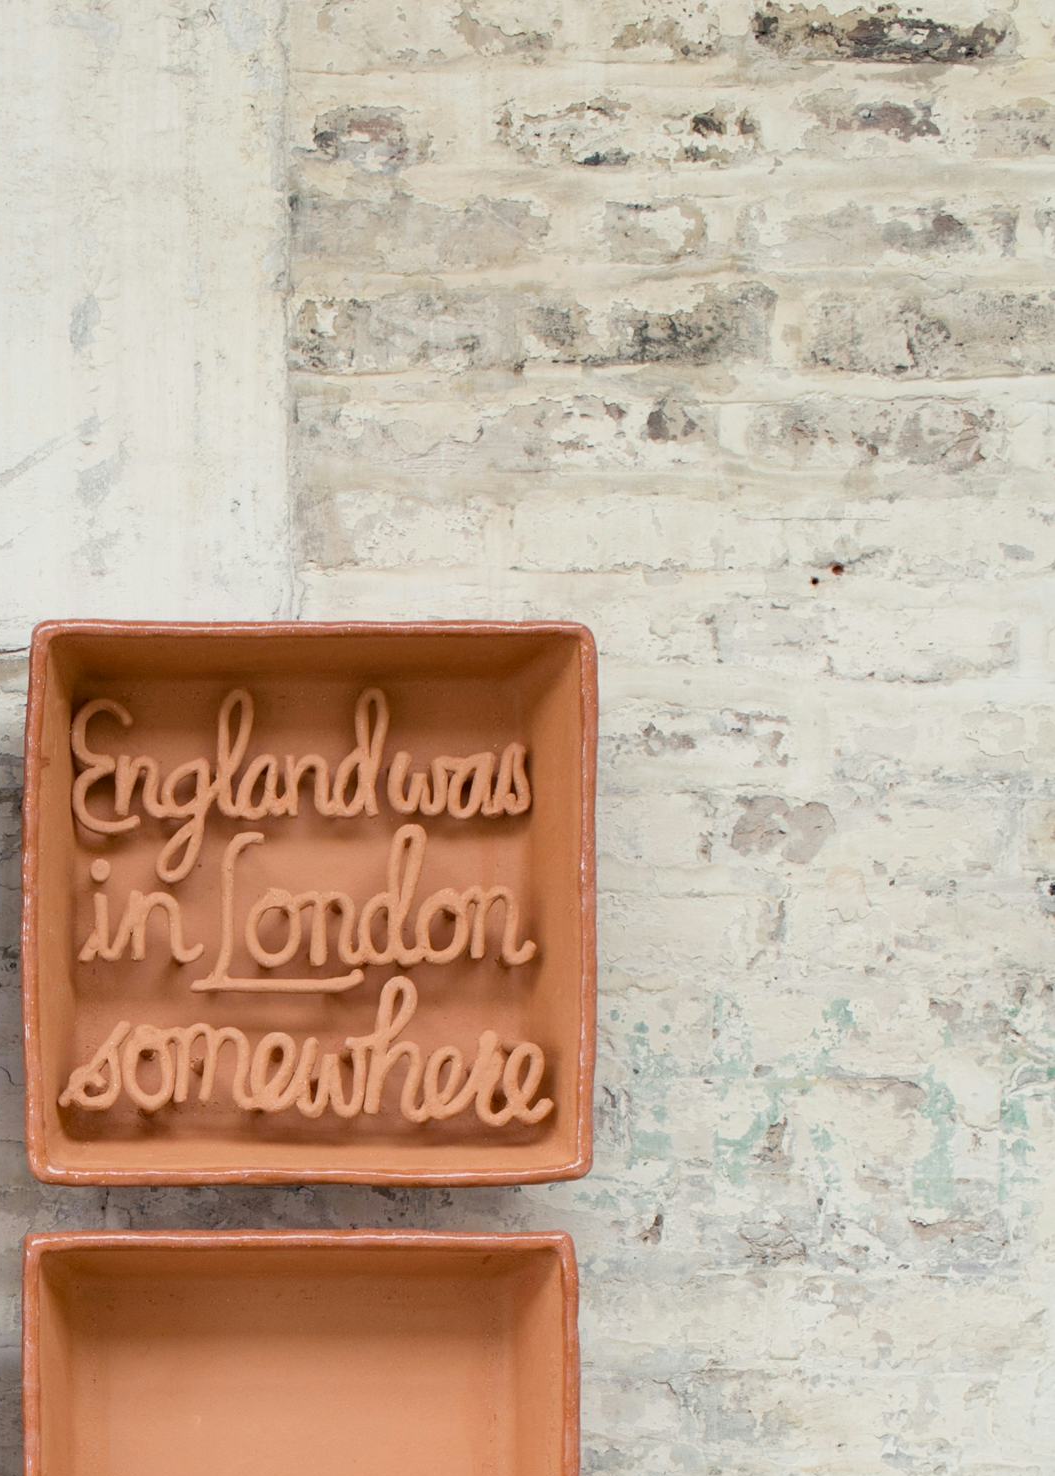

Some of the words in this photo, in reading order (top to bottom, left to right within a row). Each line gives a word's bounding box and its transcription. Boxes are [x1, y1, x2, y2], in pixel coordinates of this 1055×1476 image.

[71, 688, 390, 883] England
[388, 742, 532, 820] was
[78, 858, 204, 963] in
[191, 824, 537, 993] London
[59, 975, 554, 1127] somewhere
